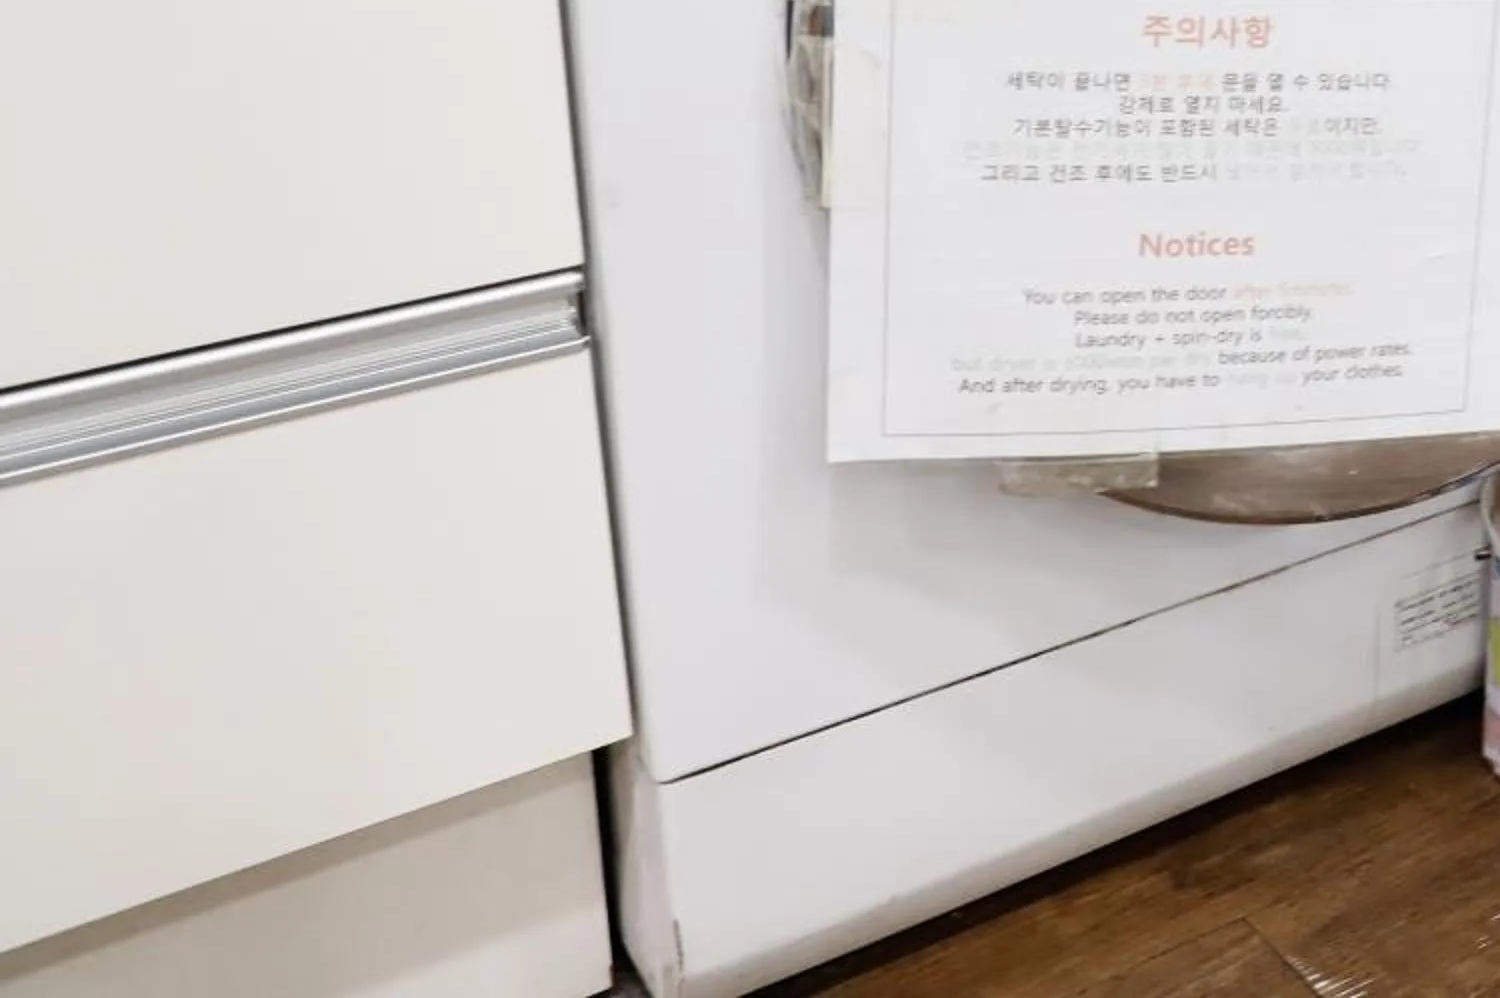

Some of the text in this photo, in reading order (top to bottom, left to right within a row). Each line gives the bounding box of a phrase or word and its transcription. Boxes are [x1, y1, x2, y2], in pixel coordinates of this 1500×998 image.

[1142, 15, 1275, 49] 주의사항
[1007, 71, 1065, 91] 세탁이
[1293, 74, 1310, 91] 수
[1184, 95, 1220, 115] 열지
[1159, 118, 1214, 138] 포함된
[981, 164, 1040, 183] 그리고
[1050, 163, 1088, 183] 건조
[1094, 163, 1152, 183] 후에도
[1161, 162, 1218, 183] 반드시
[1138, 232, 1256, 259] Notices
[1022, 288, 1057, 305] You
[1061, 290, 1093, 305] can
[1100, 289, 1146, 307] open
[1151, 286, 1180, 301] the
[1184, 286, 1226, 301] door
[1074, 310, 1129, 325] Please
[1135, 309, 1160, 324] do
[1165, 309, 1196, 324] not
[1199, 308, 1245, 325] open
[1074, 332, 1147, 351] Laundry
[1172, 329, 1243, 347] spin-dry
[1250, 328, 1263, 342] is
[1218, 348, 1287, 365] because
[1292, 345, 1311, 361] of
[1314, 346, 1366, 364] power
[958, 377, 996, 394] And
[1002, 377, 1044, 394] after
[1116, 376, 1150, 395] you
[1155, 374, 1197, 390] have
[1202, 374, 1219, 388] to
[1302, 368, 1339, 387] your
